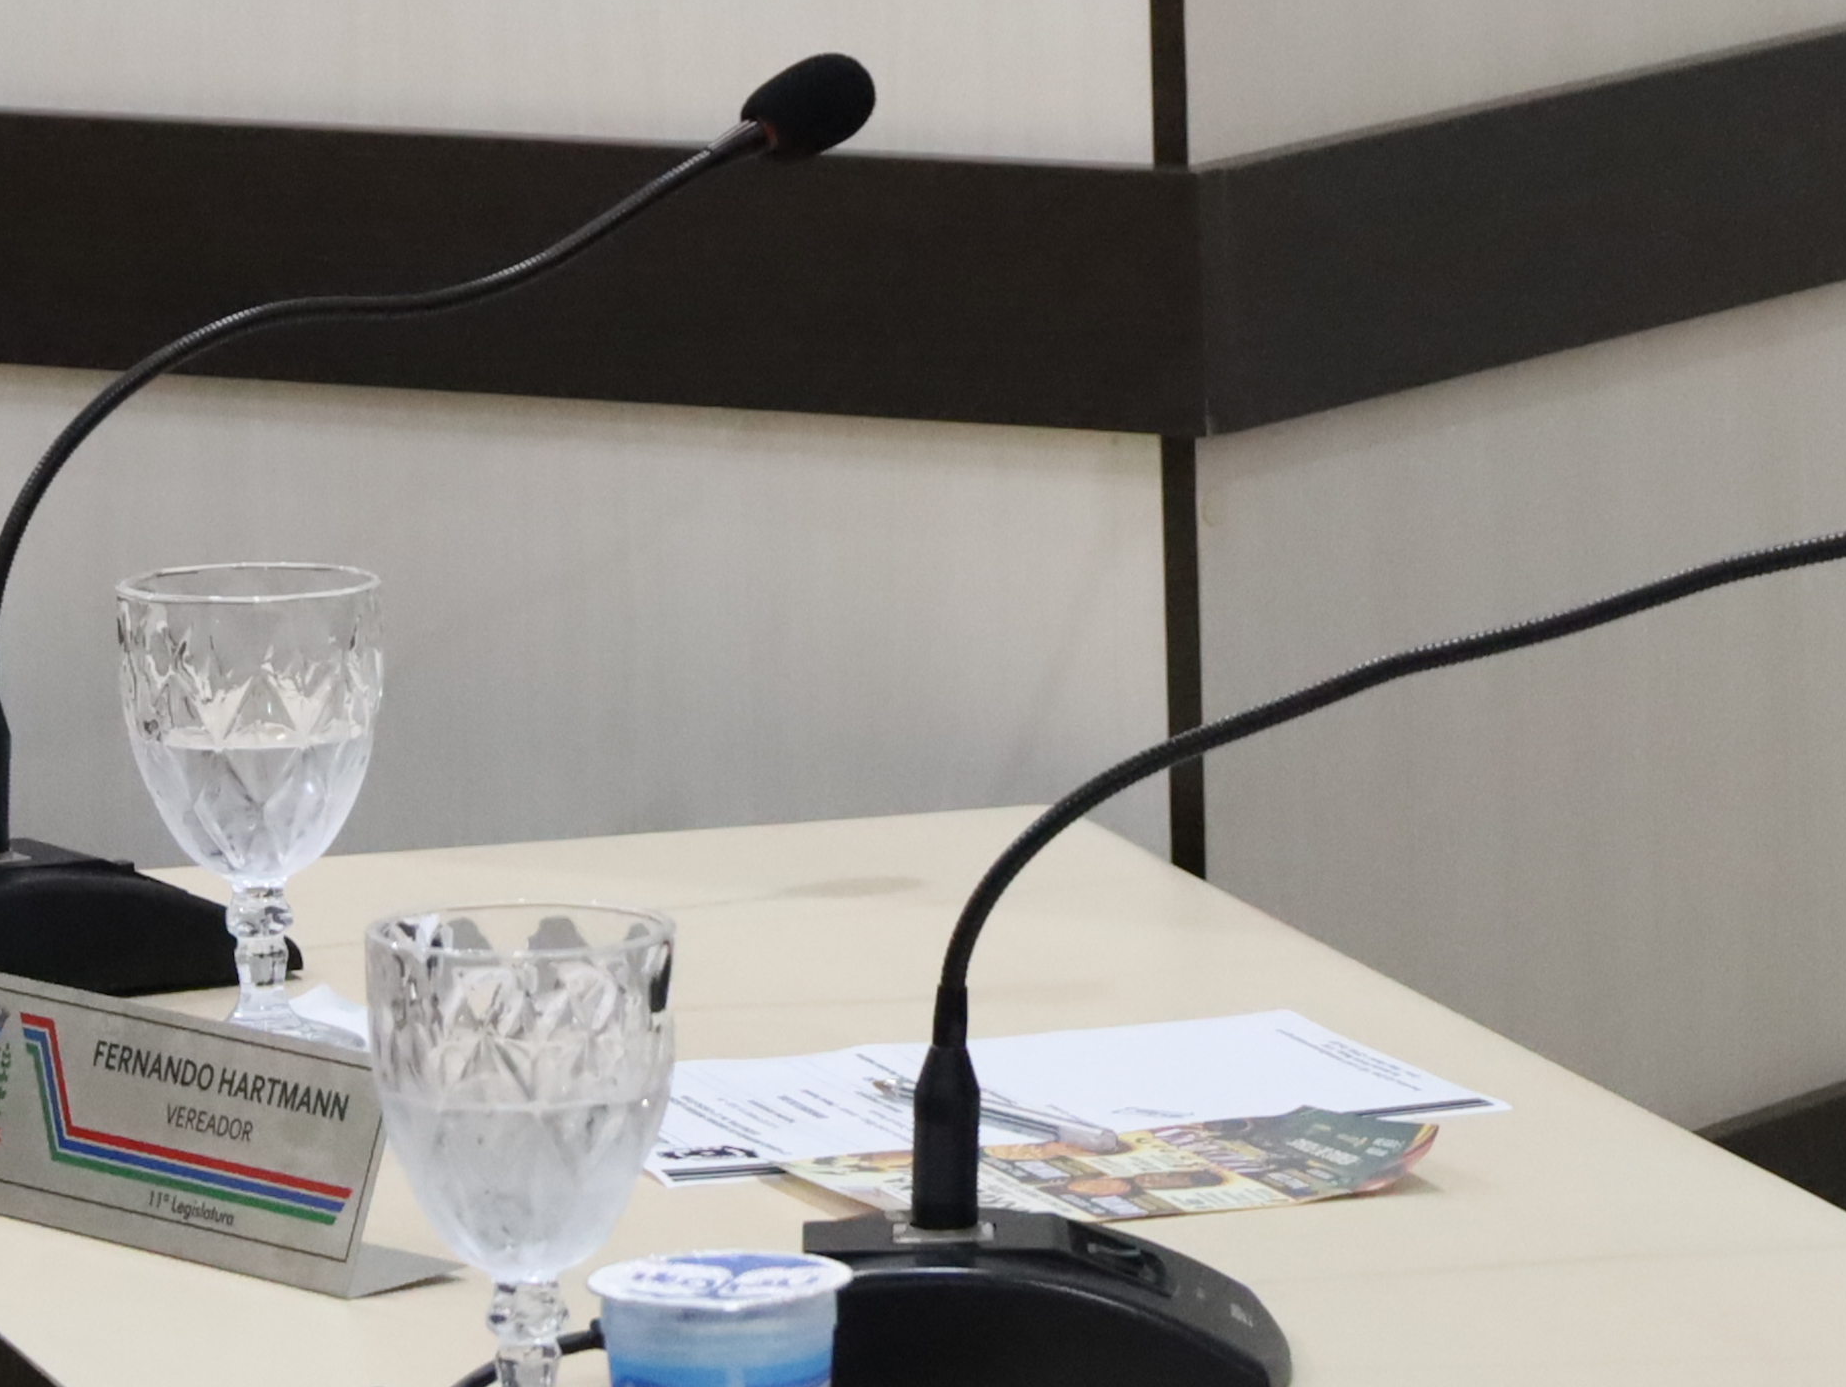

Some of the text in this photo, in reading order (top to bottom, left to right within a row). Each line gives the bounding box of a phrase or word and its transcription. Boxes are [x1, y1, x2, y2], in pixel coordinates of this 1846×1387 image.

[93, 1039, 350, 1122] FERNANDO HARTMANN
[166, 1103, 254, 1142] VEREADOR
[171, 1194, 235, 1226] Legislatura
